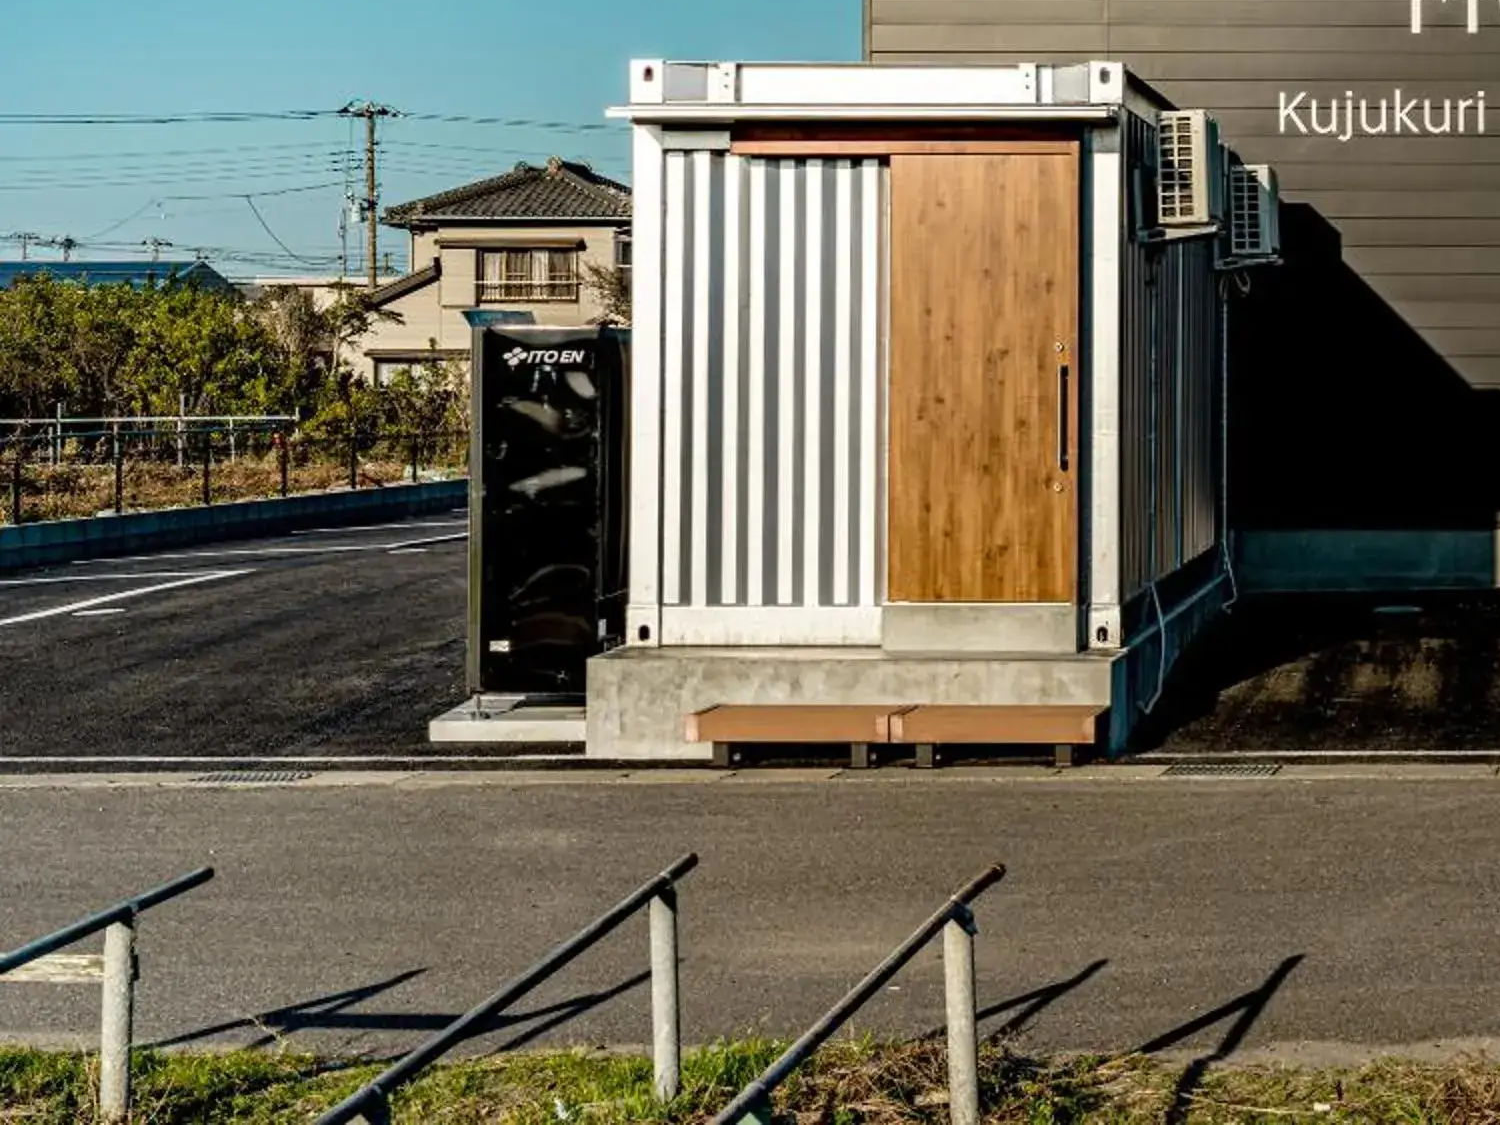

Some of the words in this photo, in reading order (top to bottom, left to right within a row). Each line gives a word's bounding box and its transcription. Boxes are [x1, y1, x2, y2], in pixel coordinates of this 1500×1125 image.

[1278, 88, 1486, 141] Kujukuri
[526, 350, 559, 364] ITO
[559, 349, 586, 364] EN
